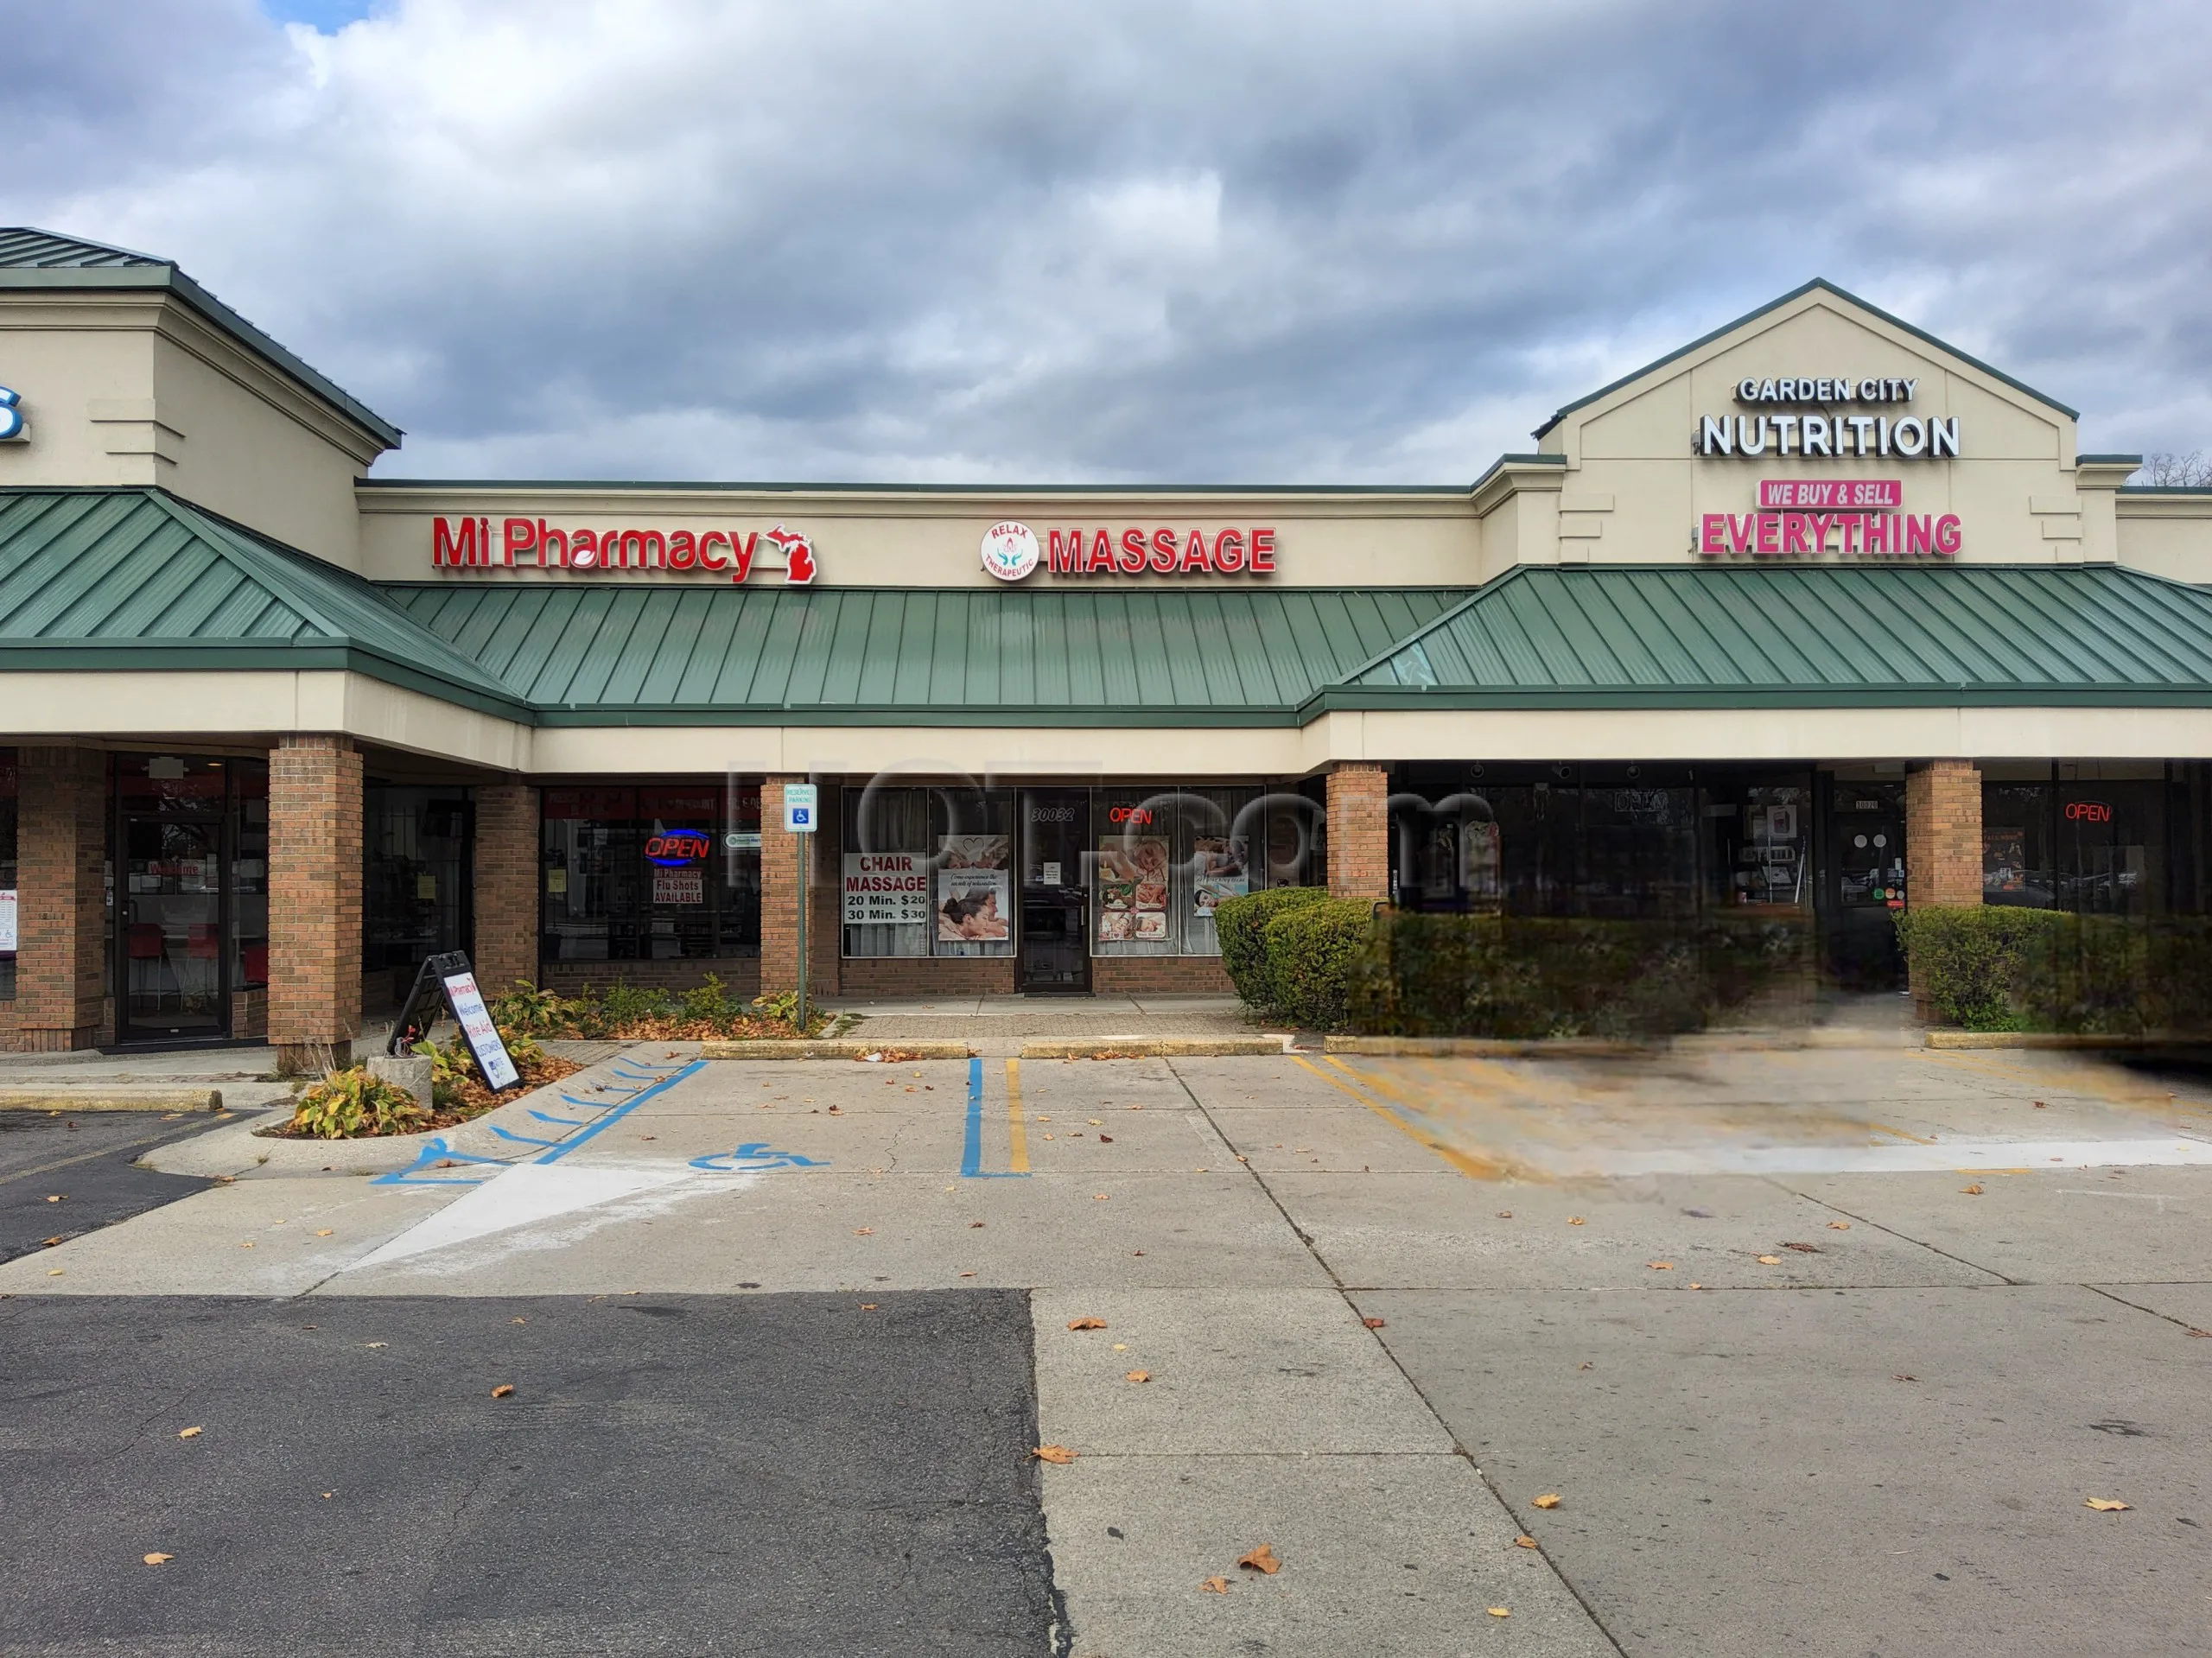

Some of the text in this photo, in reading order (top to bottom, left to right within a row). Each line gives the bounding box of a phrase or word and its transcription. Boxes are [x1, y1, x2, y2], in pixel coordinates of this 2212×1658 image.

[1737, 377, 1920, 401] GARDEN CITY
[1700, 415, 1960, 457] NUTRITION
[1768, 484, 1893, 505] WE BUY & SELL
[991, 524, 1028, 539] RELAX
[1700, 512, 1963, 555] EVERYTHING
[433, 517, 760, 583] Mi Pharmacy
[1047, 527, 1276, 573] MASSAGE
[985, 553, 1034, 577] THERAPEUTIC
[1031, 807, 1075, 822] 30032
[1109, 806, 1153, 825] OPEN
[2065, 803, 2112, 822] OPEN
[645, 836, 710, 858] OPEN
[860, 856, 913, 872] CHAIR
[664, 868, 702, 880] Pharmacy
[657, 880, 699, 891] Flu Shots
[846, 876, 926, 893] MASSAGE
[654, 893, 702, 903] AVAILABLE
[848, 894, 925, 906] 20 Min. $20
[848, 909, 925, 920] 30 Min. $30
[457, 1003, 484, 1017] Welcome
[465, 1017, 493, 1038] Rite Aid
[475, 1039, 502, 1058] CUSTOMERS
